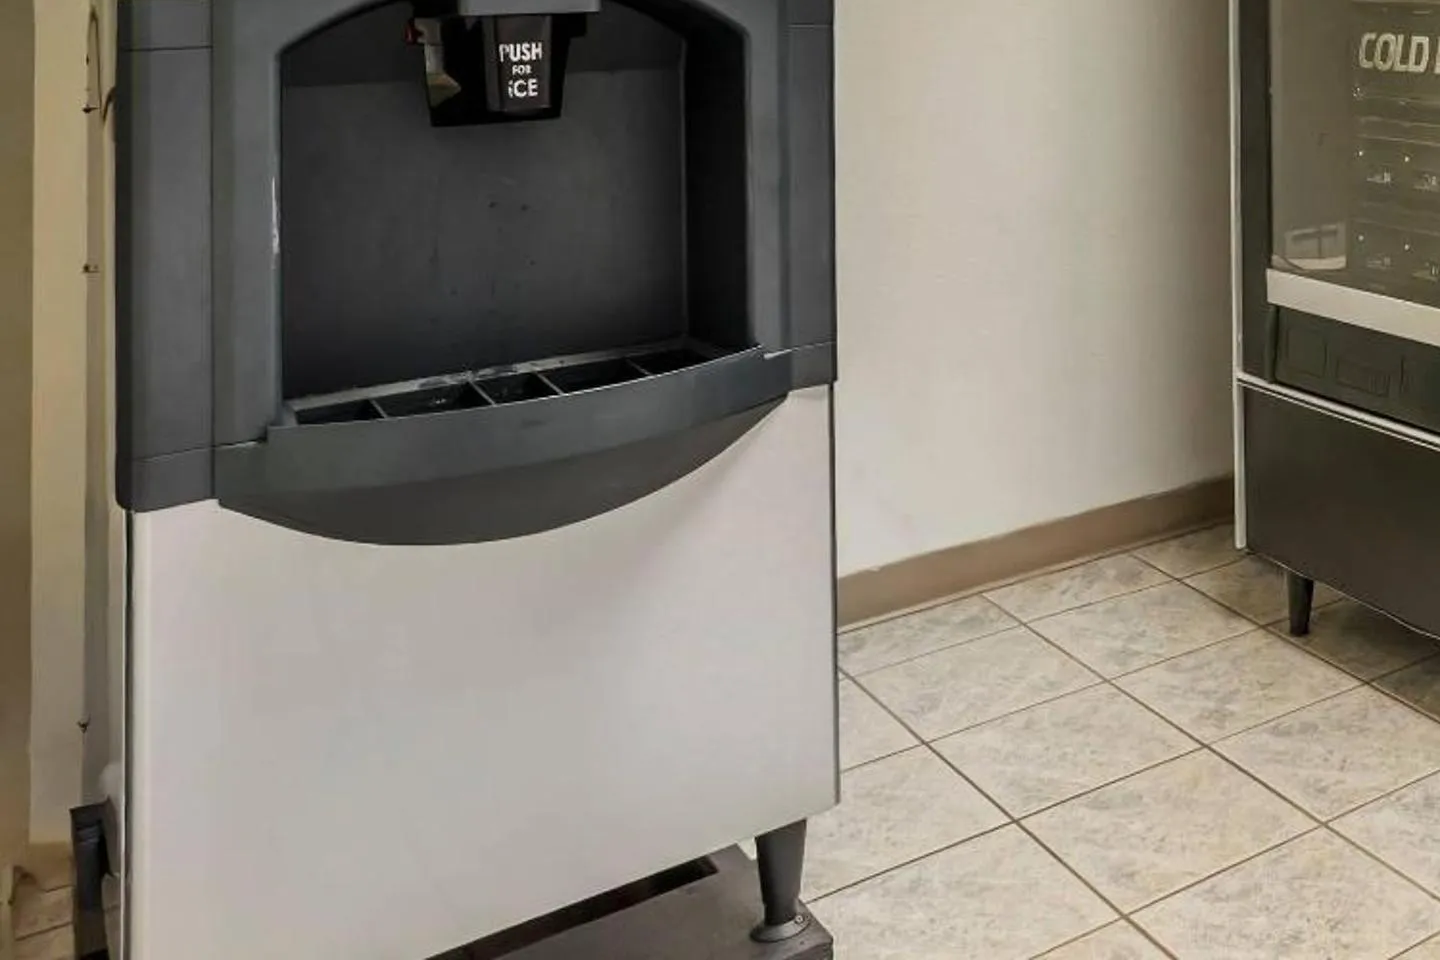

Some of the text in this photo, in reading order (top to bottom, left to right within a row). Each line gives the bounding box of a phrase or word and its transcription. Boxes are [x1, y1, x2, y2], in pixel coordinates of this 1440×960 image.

[499, 42, 543, 63] PUSH
[1359, 32, 1430, 73] COLD
[512, 64, 532, 76] FOR
[508, 79, 539, 98] ICE
